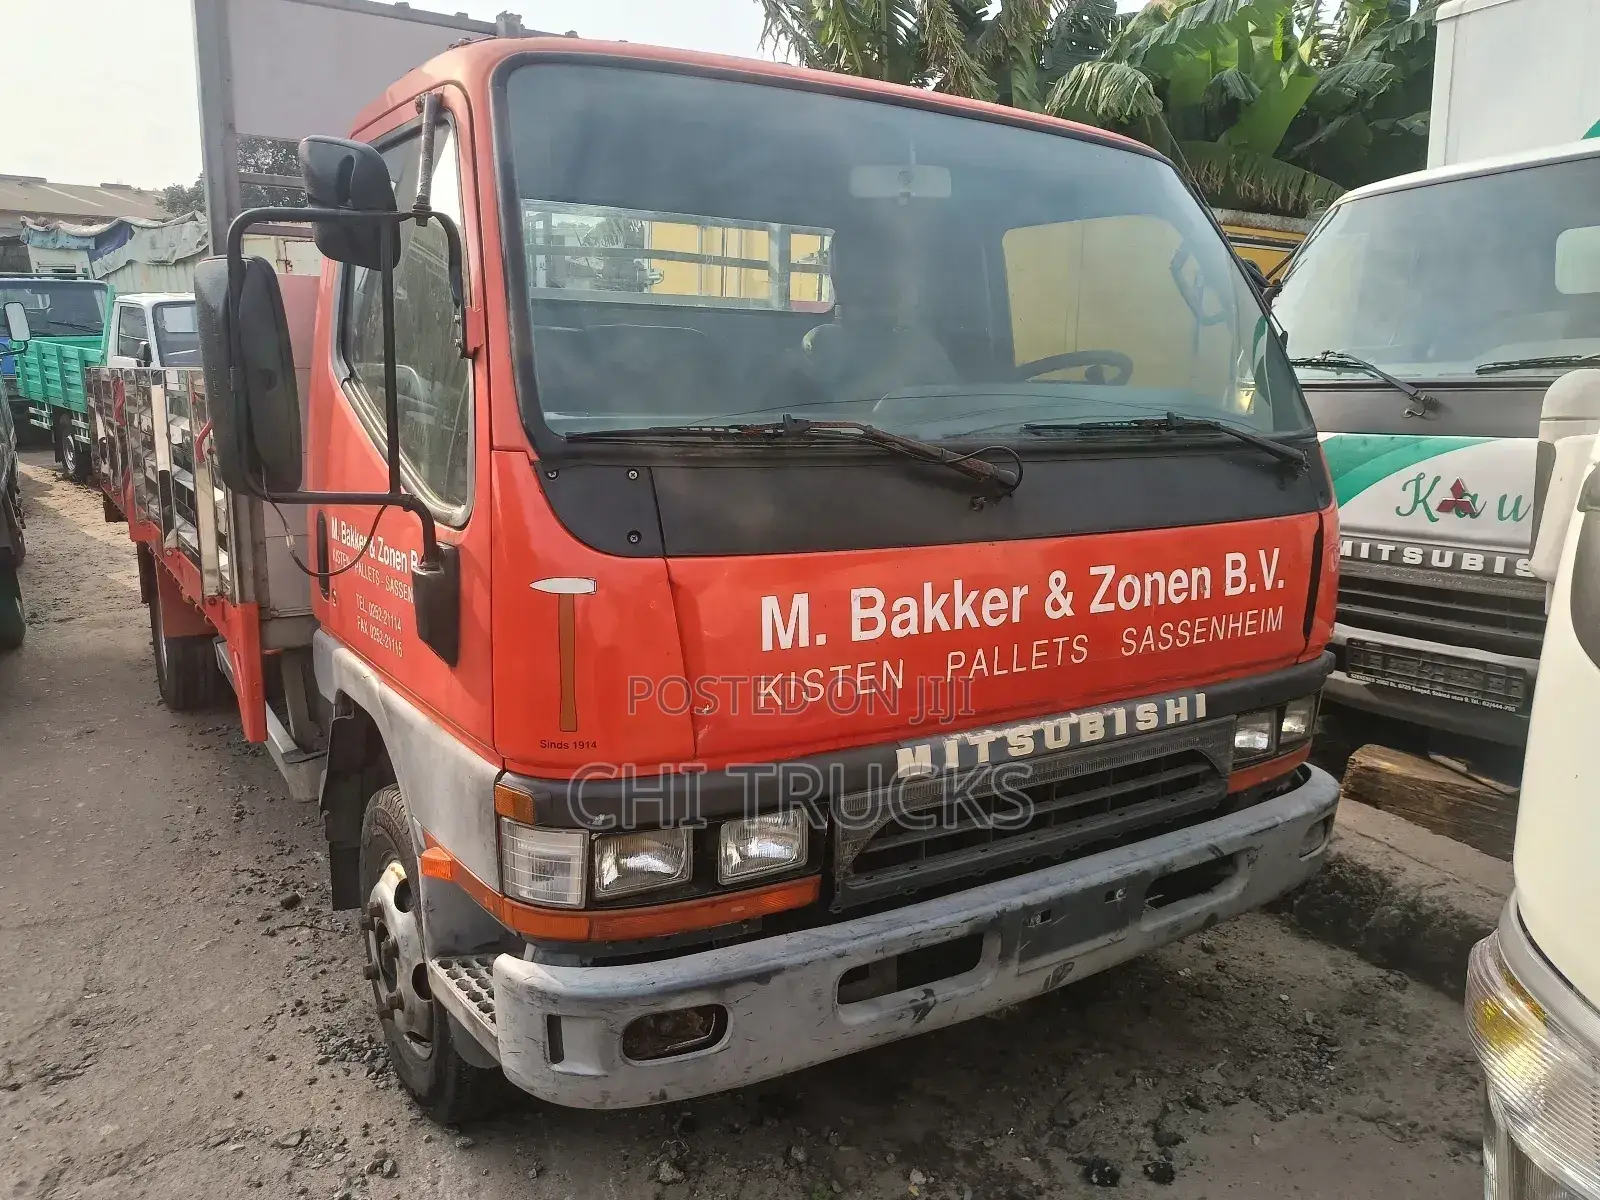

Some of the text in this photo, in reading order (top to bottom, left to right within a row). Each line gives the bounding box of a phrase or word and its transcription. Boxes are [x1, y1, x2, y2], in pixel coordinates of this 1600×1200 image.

[331, 516, 340, 541] M.
[341, 520, 369, 554] Bakker
[369, 536, 376, 559] &
[377, 536, 408, 574] Zonen
[354, 560, 380, 586] PALLETS
[761, 547, 1285, 652] M. Bakker & Zonen B.V.
[759, 605, 1284, 708] KISTEN PALLETS SASSENHEIM
[540, 739, 598, 750] Sinds 1914
[896, 692, 1206, 778] MITSUBISHI
